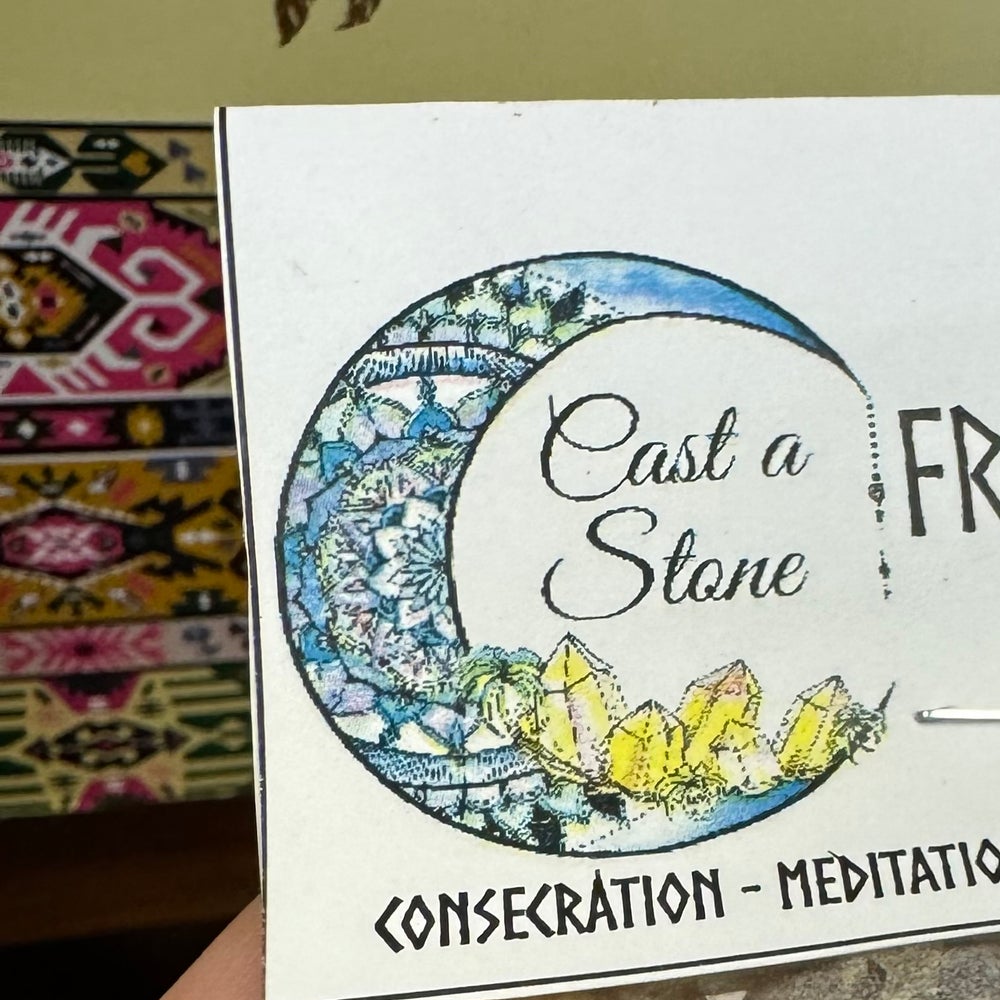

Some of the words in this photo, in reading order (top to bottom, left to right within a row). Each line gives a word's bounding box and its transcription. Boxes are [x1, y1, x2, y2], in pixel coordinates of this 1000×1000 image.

[541, 393, 739, 502] Cast
[761, 433, 814, 477] a
[541, 506, 810, 621] Stone
[374, 868, 726, 954] CONSECRATION
